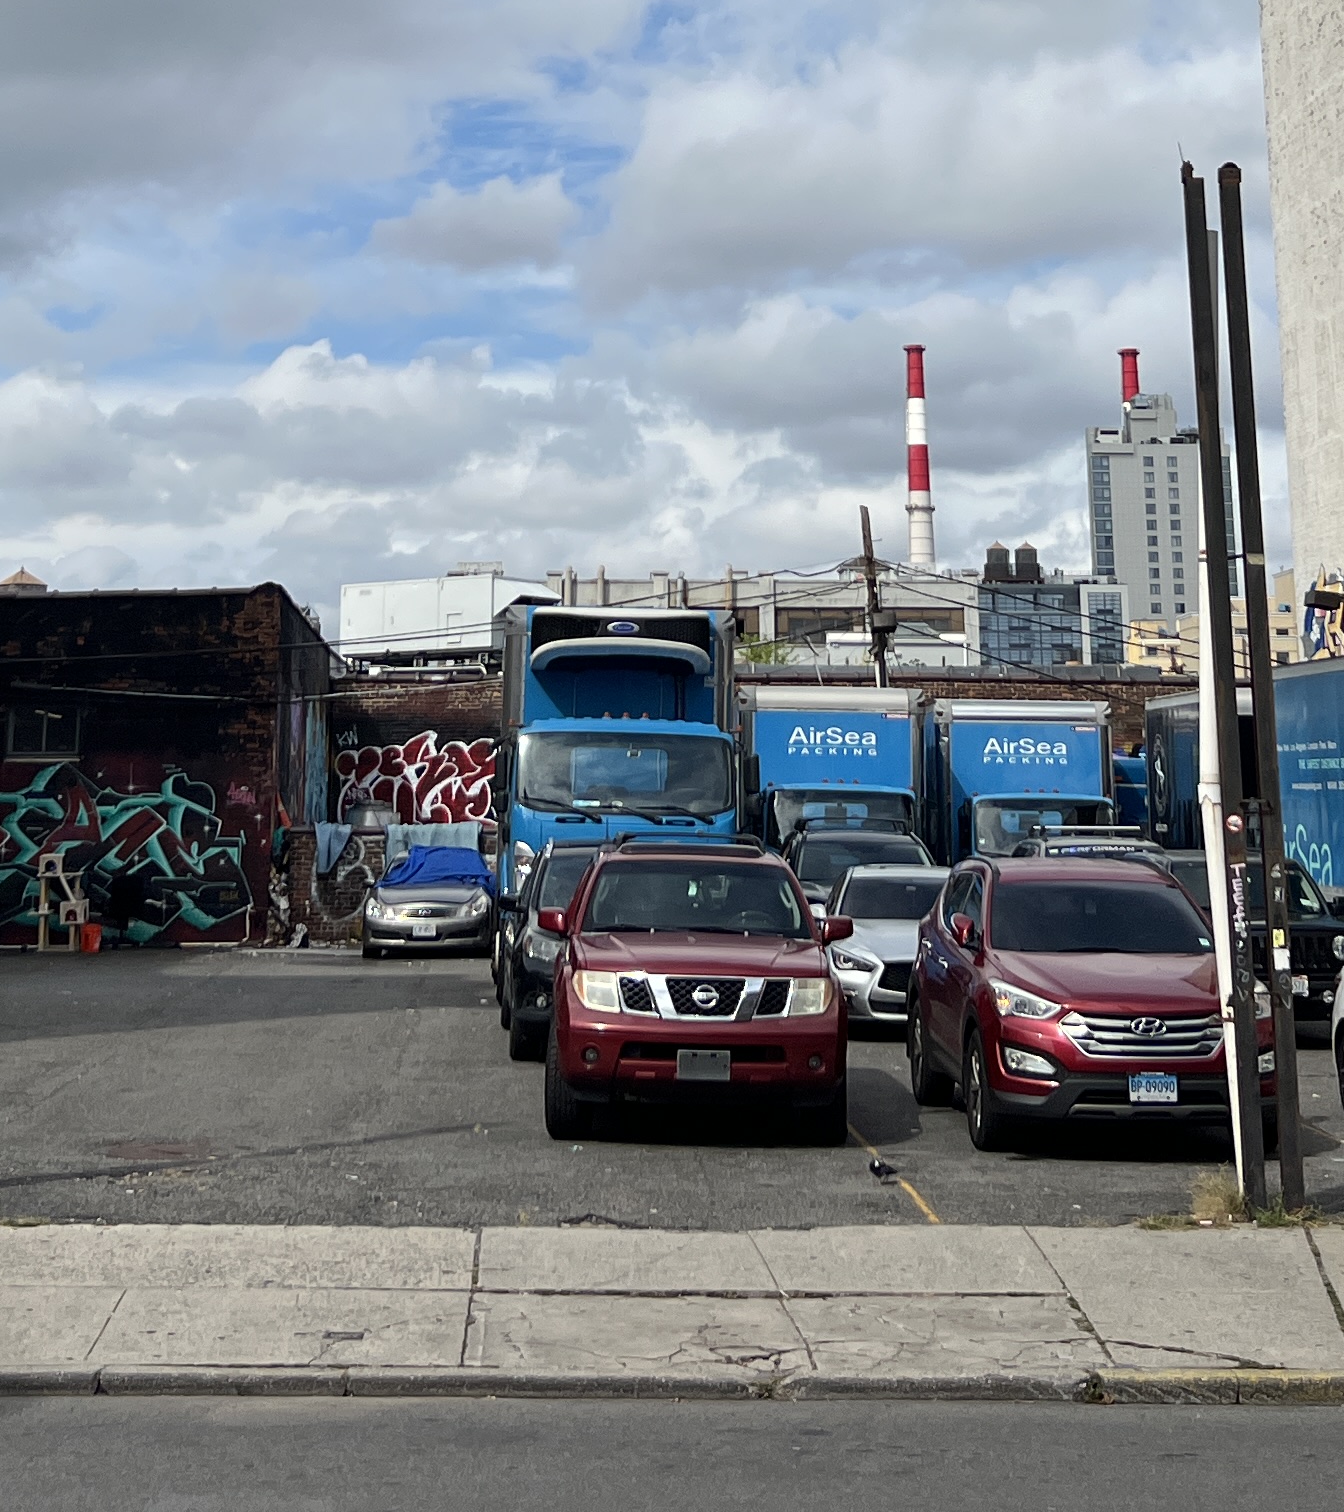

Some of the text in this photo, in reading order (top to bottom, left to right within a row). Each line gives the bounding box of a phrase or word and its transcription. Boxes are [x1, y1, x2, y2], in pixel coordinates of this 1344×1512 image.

[788, 726, 877, 745] AirSea
[788, 747, 878, 756] PACKING
[983, 737, 1067, 755] AirSea
[983, 756, 1068, 765] PACKING
[1282, 823, 1333, 888] irSea
